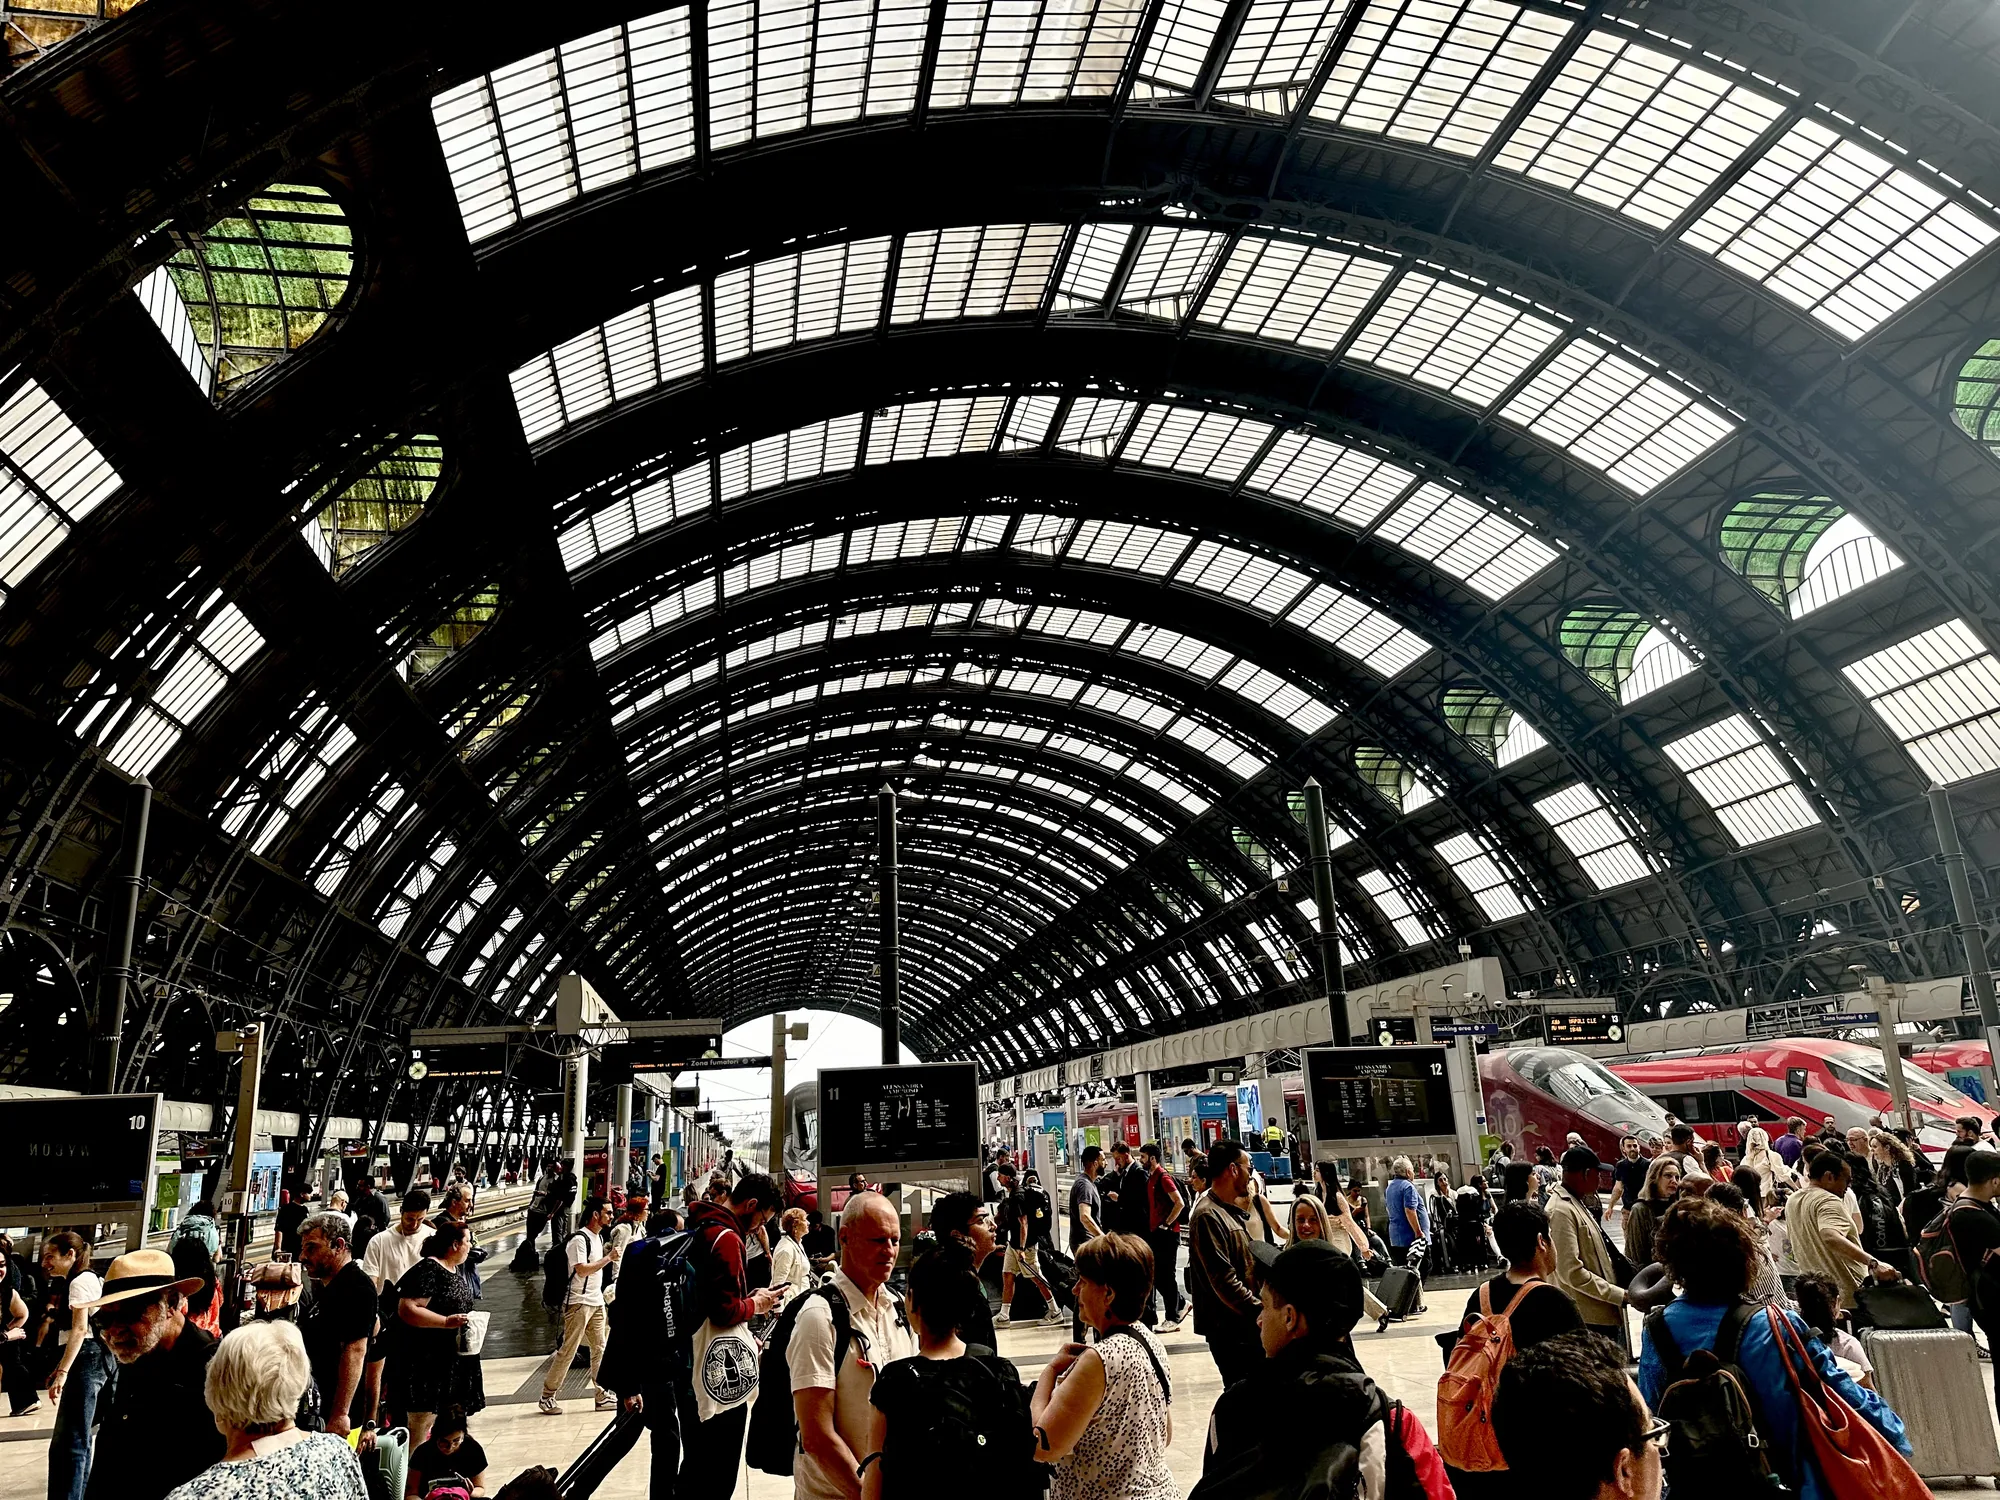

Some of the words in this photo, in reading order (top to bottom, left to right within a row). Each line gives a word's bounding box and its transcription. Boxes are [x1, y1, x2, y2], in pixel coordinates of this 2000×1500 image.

[1611, 1014, 1619, 1023] 13
[1379, 1021, 1388, 1029] 12
[709, 1038, 717, 1047] 11
[411, 1049, 422, 1059] 10
[1430, 1062, 1443, 1076] 12
[827, 1087, 840, 1100] 11
[129, 1115, 146, 1130] 10
[223, 1198, 233, 1206] 10
[663, 1281, 677, 1338] patagonia
